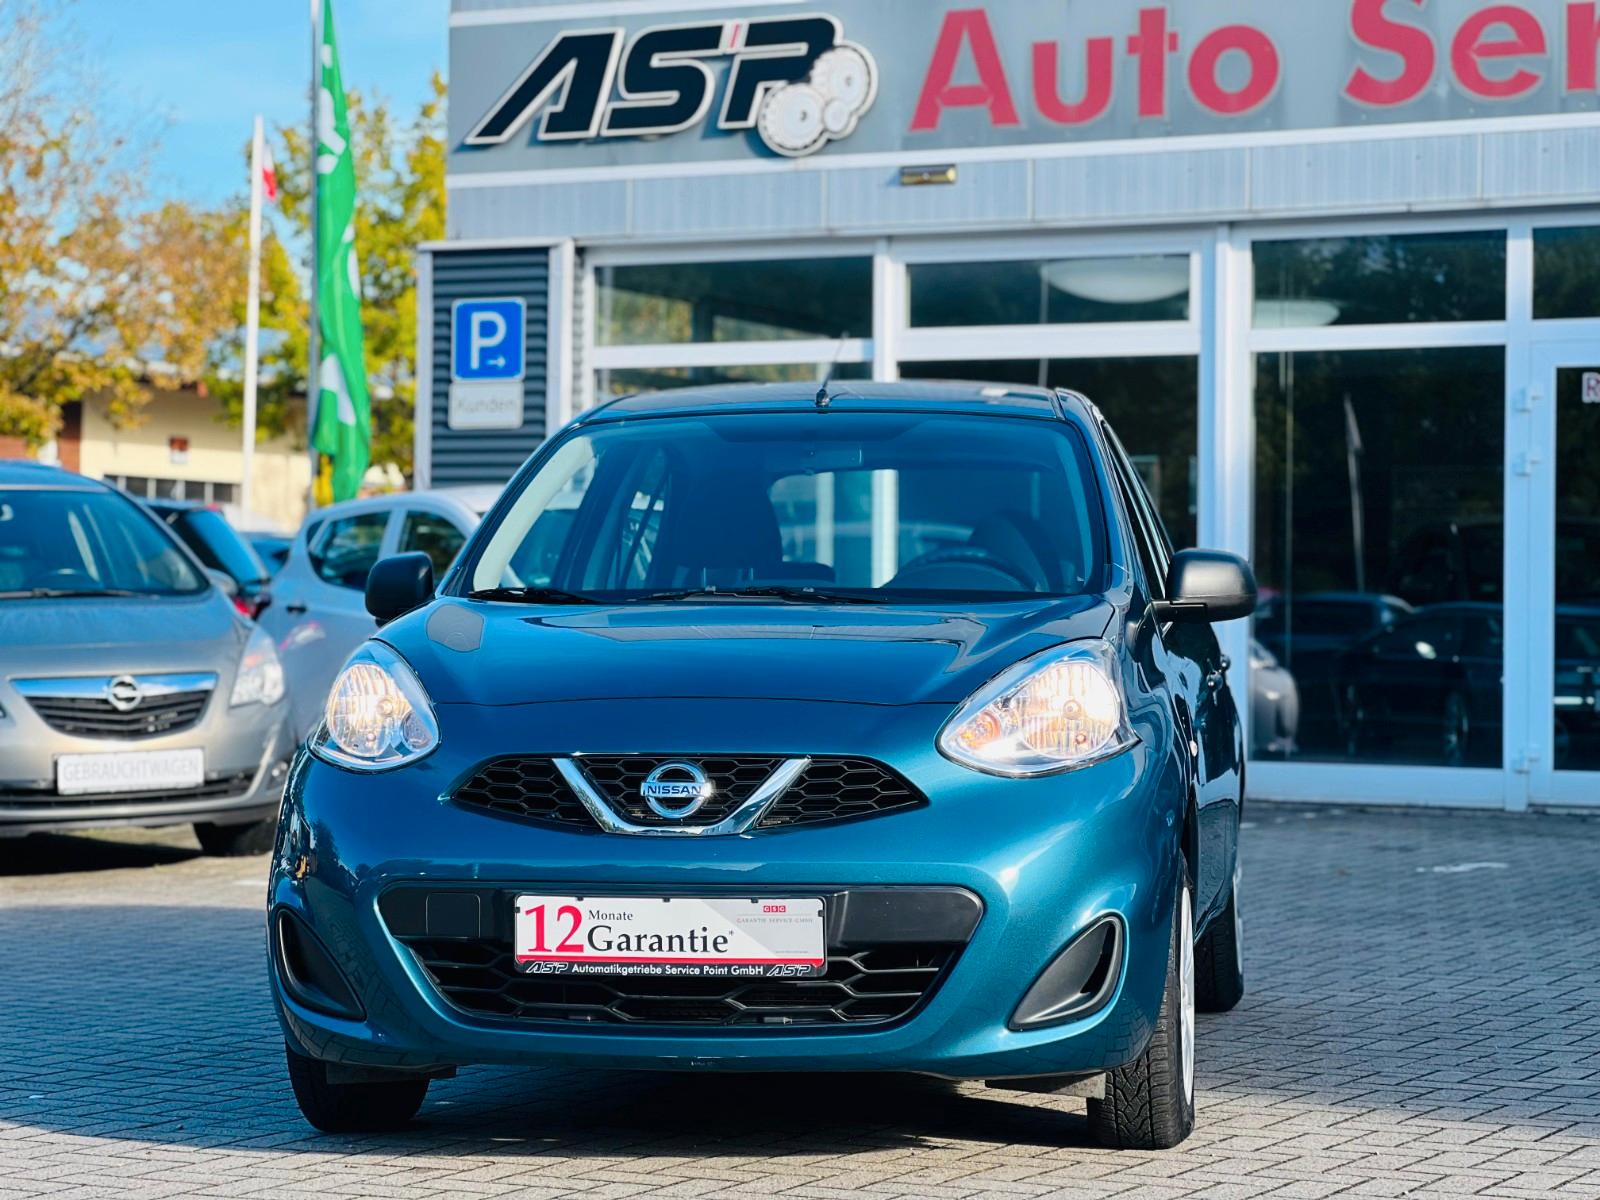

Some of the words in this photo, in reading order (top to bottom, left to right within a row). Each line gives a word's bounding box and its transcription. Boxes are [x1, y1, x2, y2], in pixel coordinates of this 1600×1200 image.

[465, 12, 847, 145] ASP
[908, 8, 1280, 131] Auto
[470, 311, 507, 370] P
[457, 394, 517, 412] Kunden
[63, 758, 199, 782] GEBRAUCHTWAGEN
[647, 785, 702, 795] NISSAN
[588, 910, 634, 921] Monate
[525, 904, 584, 953] 12
[526, 961, 569, 974] ASP
[572, 964, 662, 976] Automatikgetriebe
[665, 964, 700, 975] Service
[703, 965, 728, 975] Point
[731, 965, 763, 975] GmbH
[766, 964, 811, 977] ASP
